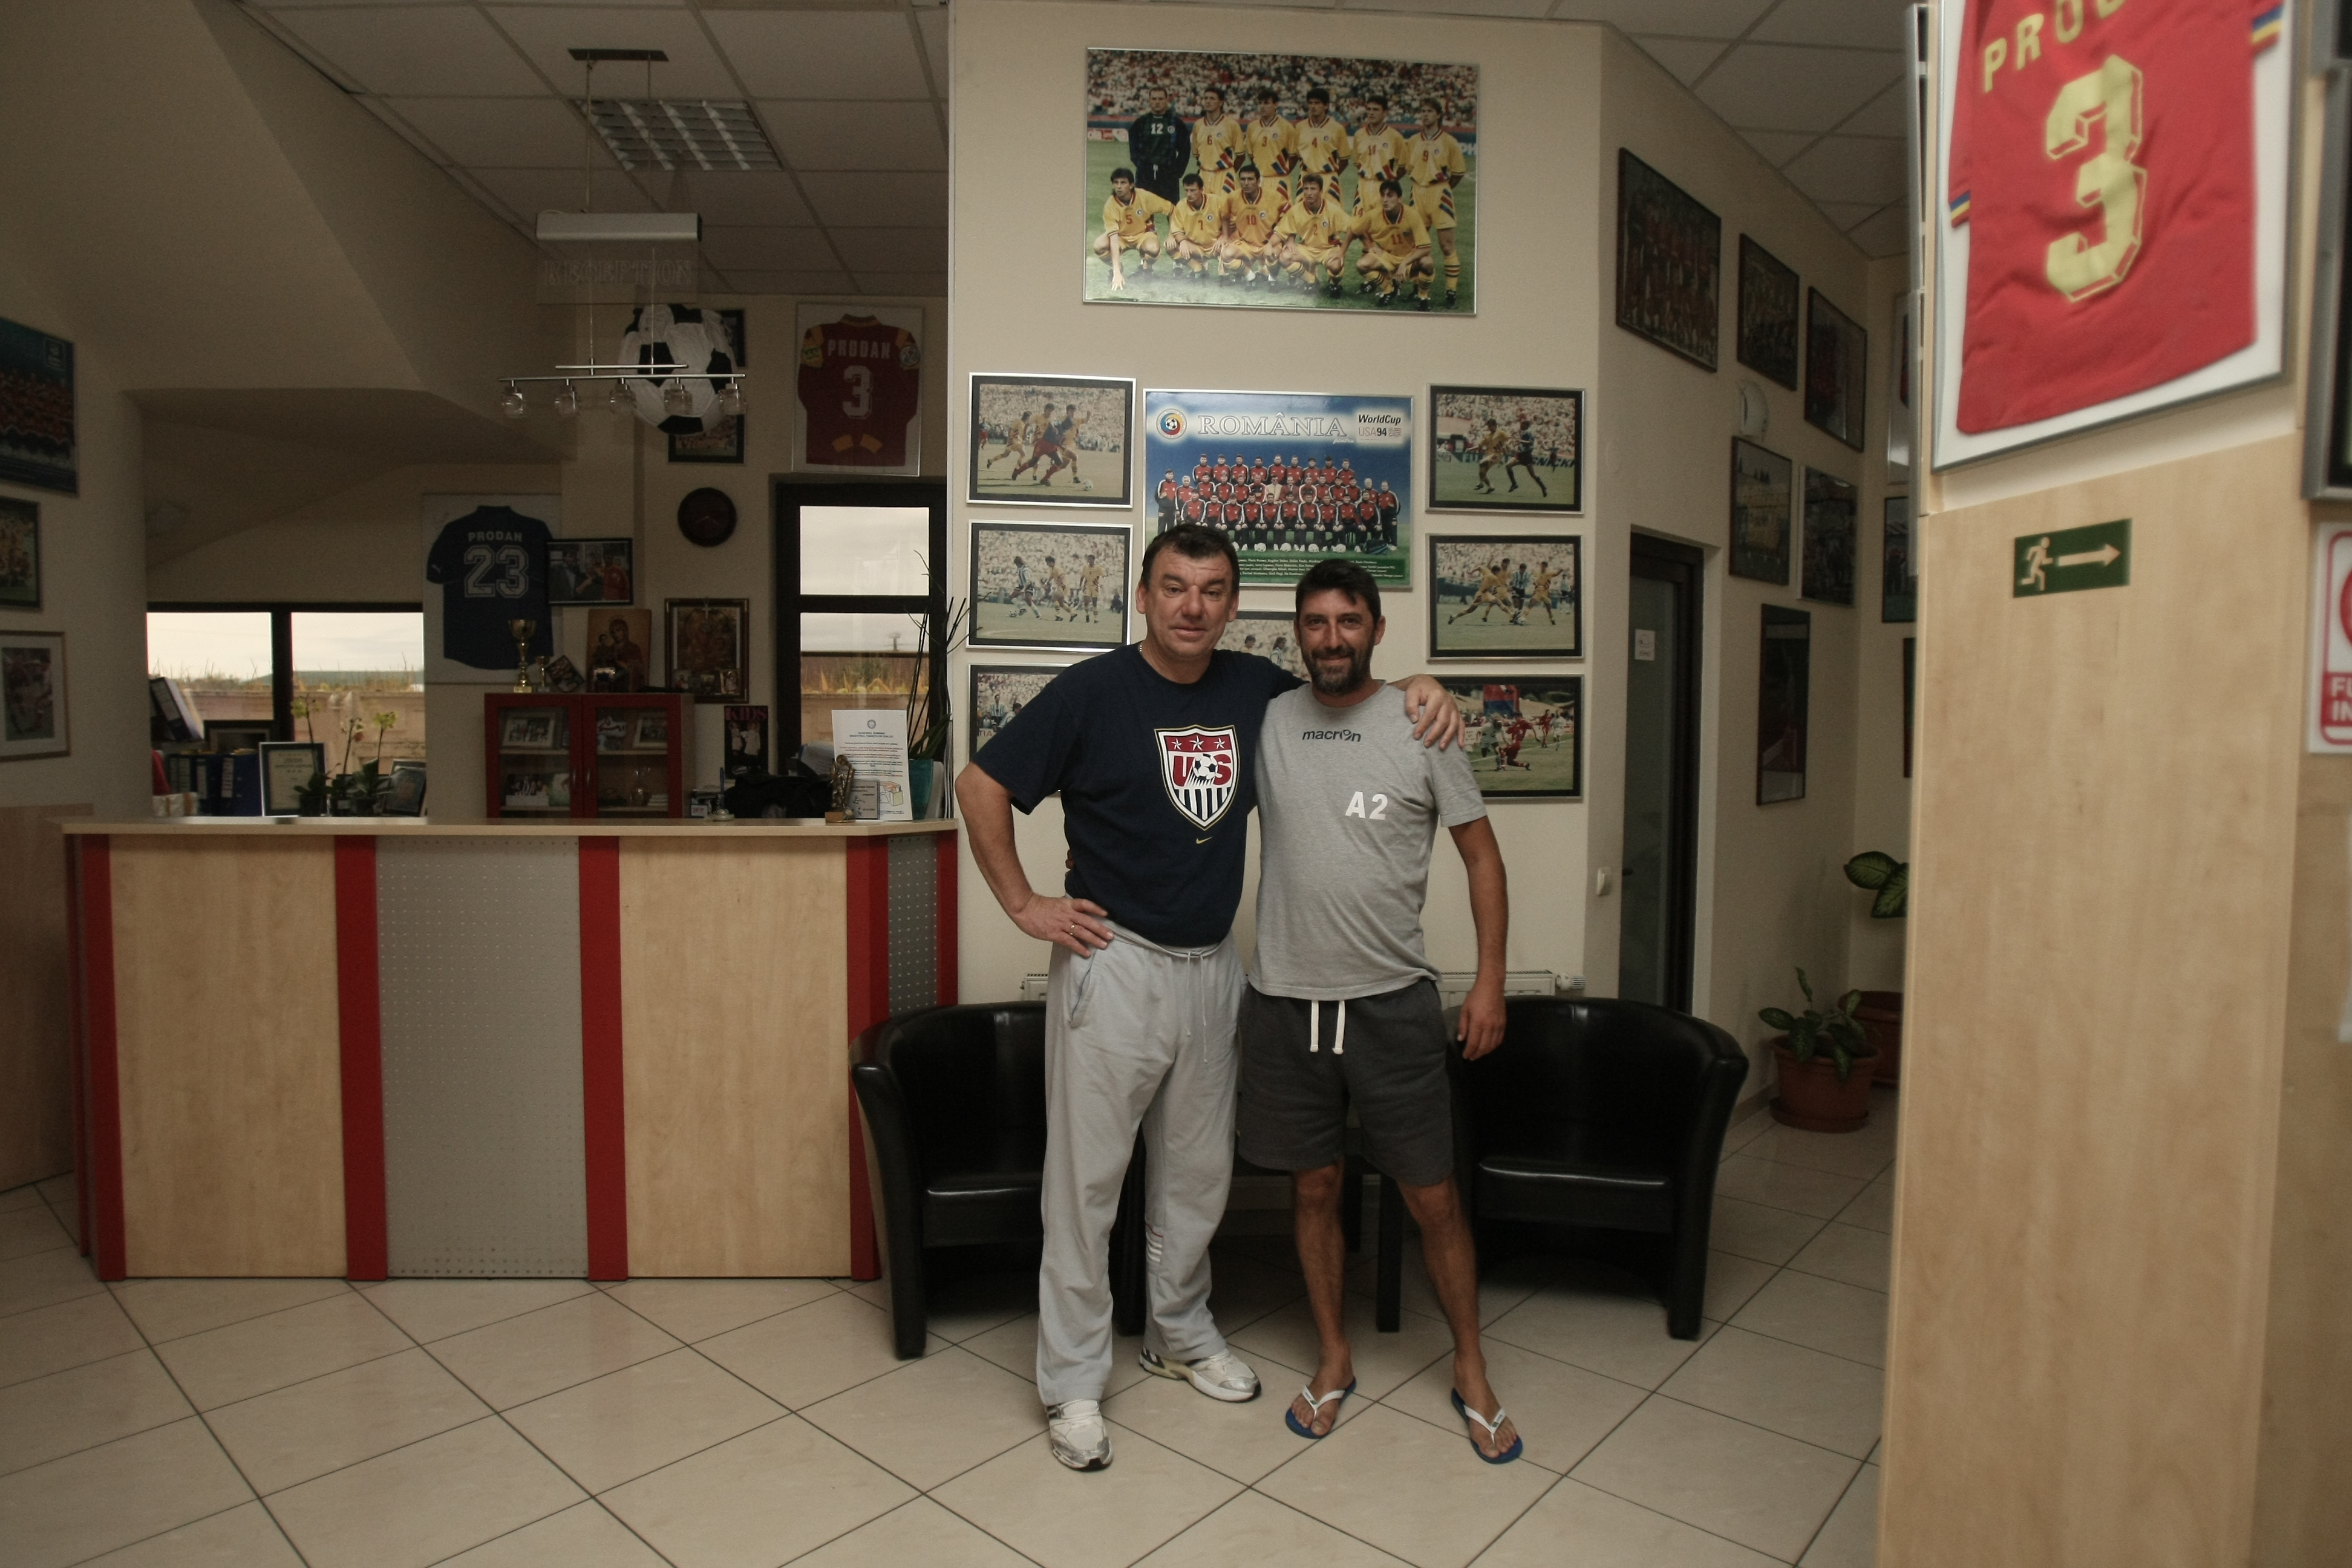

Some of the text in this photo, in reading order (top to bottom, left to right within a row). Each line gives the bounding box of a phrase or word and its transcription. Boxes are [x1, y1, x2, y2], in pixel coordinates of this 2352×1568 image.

[1151, 123, 1163, 134] 12
[1207, 134, 1213, 145] 6
[1261, 136, 1267, 147] 3
[1312, 137, 1318, 148] 4
[1423, 150, 1429, 162] 9
[2045, 53, 2148, 303] 3
[1126, 214, 1132, 224] 5
[1246, 215, 1257, 225] 10
[1198, 221, 1204, 230] 7
[1391, 234, 1404, 245] 11
[828, 339, 890, 359] PRODAN
[843, 365, 873, 420] 3
[1198, 411, 1347, 437] ROMÂNIA
[1359, 414, 1401, 426] WorldCup
[468, 531, 523, 542] PRODAN
[464, 544, 529, 598] 23
[730, 707, 767, 720] KIDS
[1302, 729, 1361, 742] macron
[1345, 791, 1388, 820] A2
